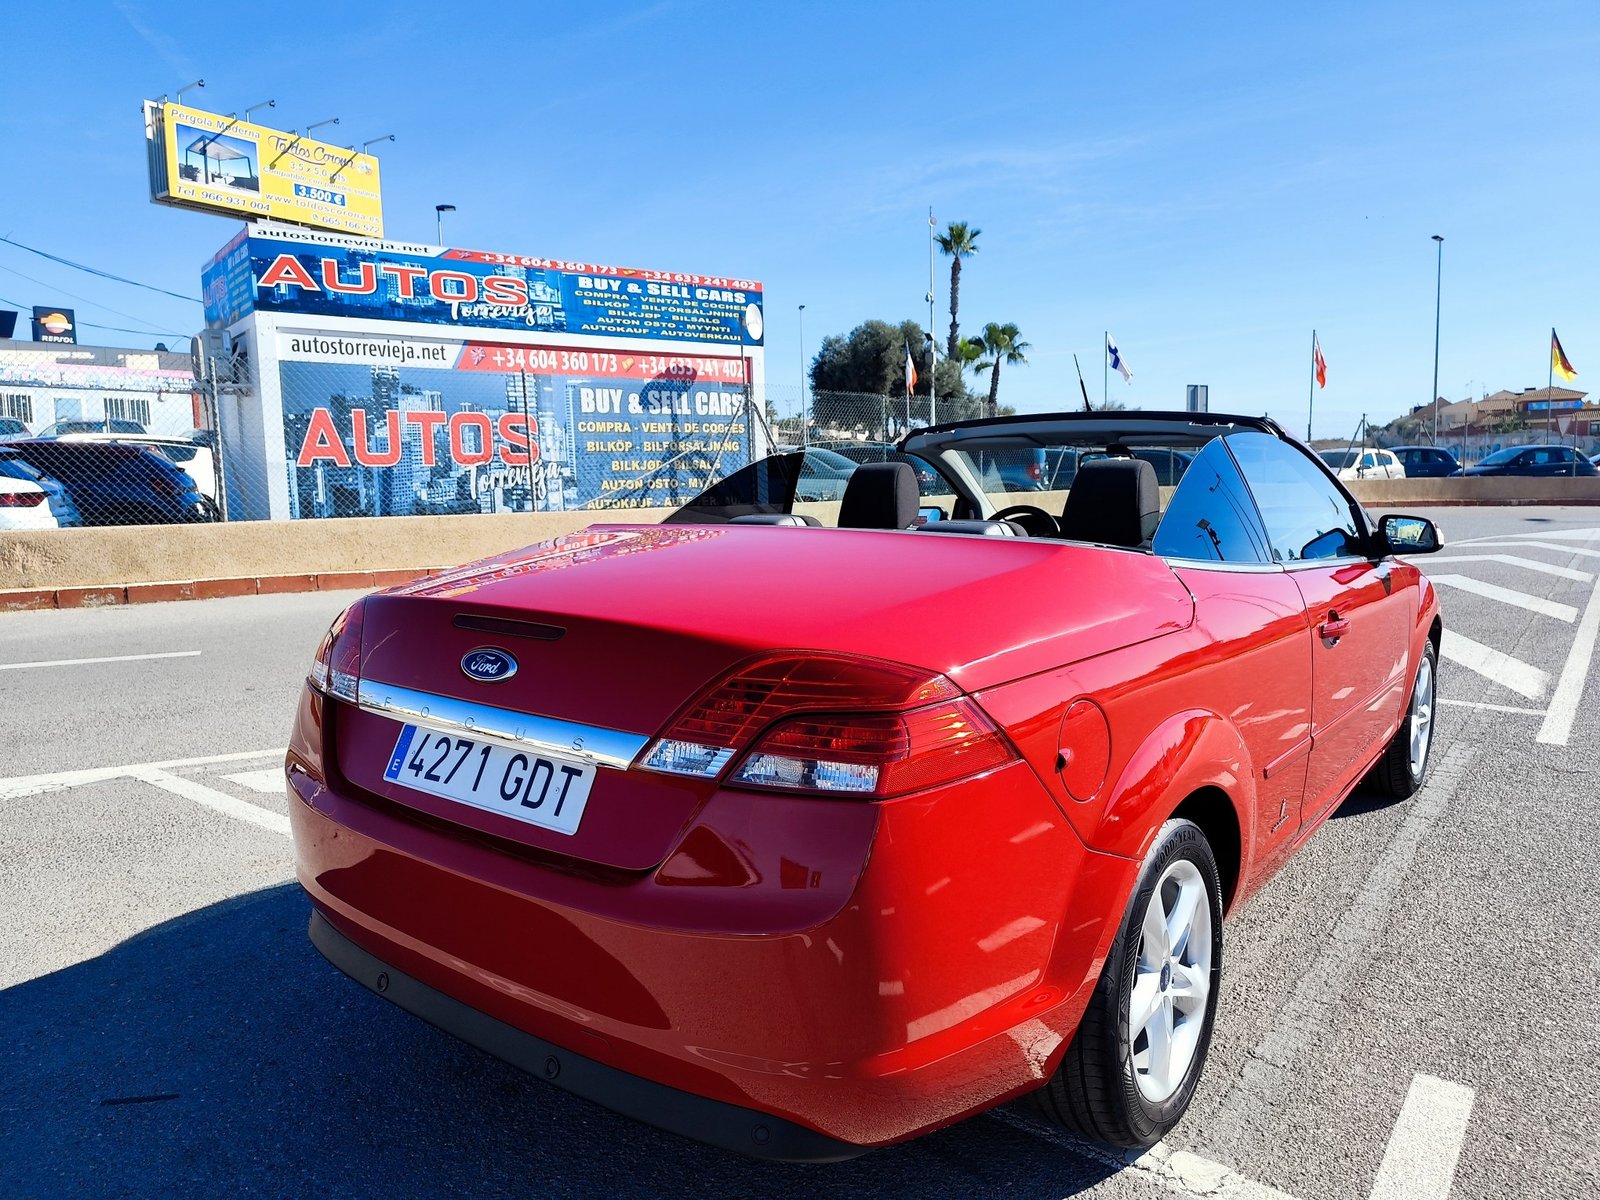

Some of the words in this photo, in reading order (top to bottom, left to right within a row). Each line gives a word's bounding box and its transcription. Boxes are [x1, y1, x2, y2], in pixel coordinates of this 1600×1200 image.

[171, 109, 213, 125] Pérgola
[216, 120, 260, 139] Moderna
[268, 135, 311, 157] Toldos
[201, 191, 223, 203] 966
[226, 196, 247, 207] 931
[250, 200, 270, 212] 004
[298, 186, 332, 203] 3.500
[333, 193, 344, 206] €
[321, 215, 341, 226] 665
[257, 228, 430, 254] autostorrevieja.net
[480, 253, 517, 265] +34
[520, 256, 553, 269] 604
[556, 260, 586, 272] 360
[590, 264, 618, 276] 173
[257, 253, 529, 308] AUTOS
[578, 275, 622, 292] BUY
[626, 281, 643, 294] &
[646, 282, 691, 299] SELL
[695, 288, 746, 304] CARS
[641, 270, 671, 282] +34
[674, 273, 700, 285] 633
[703, 276, 728, 288] 241
[731, 280, 756, 291] 402
[574, 290, 629, 300] COMPRA
[640, 296, 680, 305] VENTA
[583, 299, 630, 309] BILKÖP
[444, 299, 553, 327] Torrevieja
[671, 314, 720, 325] BILSALG
[581, 323, 650, 334] AUTOKAUF
[597, 317, 640, 326] AUTON
[643, 320, 676, 328] OSTO
[686, 323, 731, 333] MYYNTI
[41, 335, 74, 344] REPSOL
[291, 337, 447, 362] autostorrevieja.net
[492, 347, 525, 369] +34
[528, 350, 558, 370] 604
[561, 351, 588, 371] 360
[592, 353, 618, 373] 173
[638, 356, 666, 375] +34
[669, 357, 694, 376] 633
[696, 358, 720, 377] 241
[722, 359, 744, 378] 402
[580, 387, 623, 414] BUY
[627, 392, 644, 415] &
[647, 389, 692, 415] SELL
[695, 391, 744, 416] CARS
[296, 407, 540, 468] AUTOS
[577, 421, 632, 433] COMPRA
[641, 422, 680, 433] VENTA
[684, 423, 699, 433] DE
[586, 439, 633, 452] BILKÖP
[464, 459, 562, 500] Torrevieja
[601, 479, 643, 491] AUTON
[647, 478, 679, 490] OSTO
[470, 654, 501, 674] Ford
[383, 696, 585, 752] FOCUS
[391, 758, 400, 771] E
[408, 733, 492, 793] 4271
[500, 754, 583, 817] GDT
